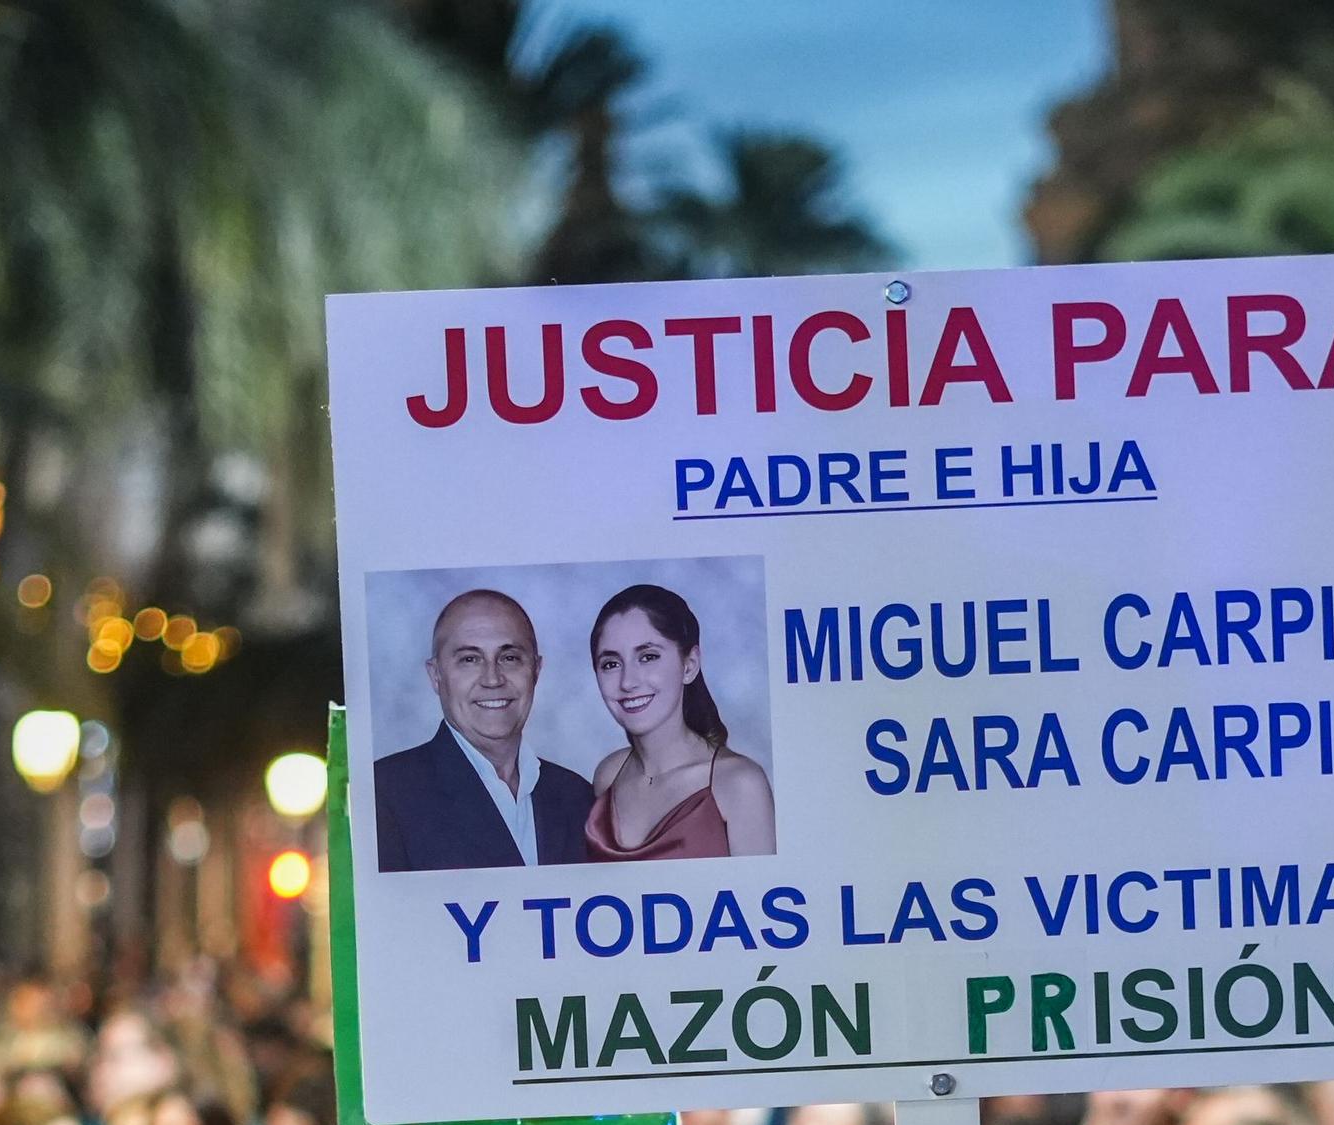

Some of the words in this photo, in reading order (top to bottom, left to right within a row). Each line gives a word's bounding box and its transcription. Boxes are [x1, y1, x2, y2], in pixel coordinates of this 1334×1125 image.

[406, 307, 1014, 429] JUSTICIA
[675, 451, 910, 510] PADRE
[935, 448, 975, 499] E
[1001, 440, 1157, 497] HIJA
[784, 599, 1079, 683] MIGUEL
[865, 713, 1080, 796] SARA
[444, 901, 496, 962] Y
[523, 887, 809, 959] TODAS
[841, 879, 998, 945] LAS
[516, 966, 872, 1072] MAZÓN
